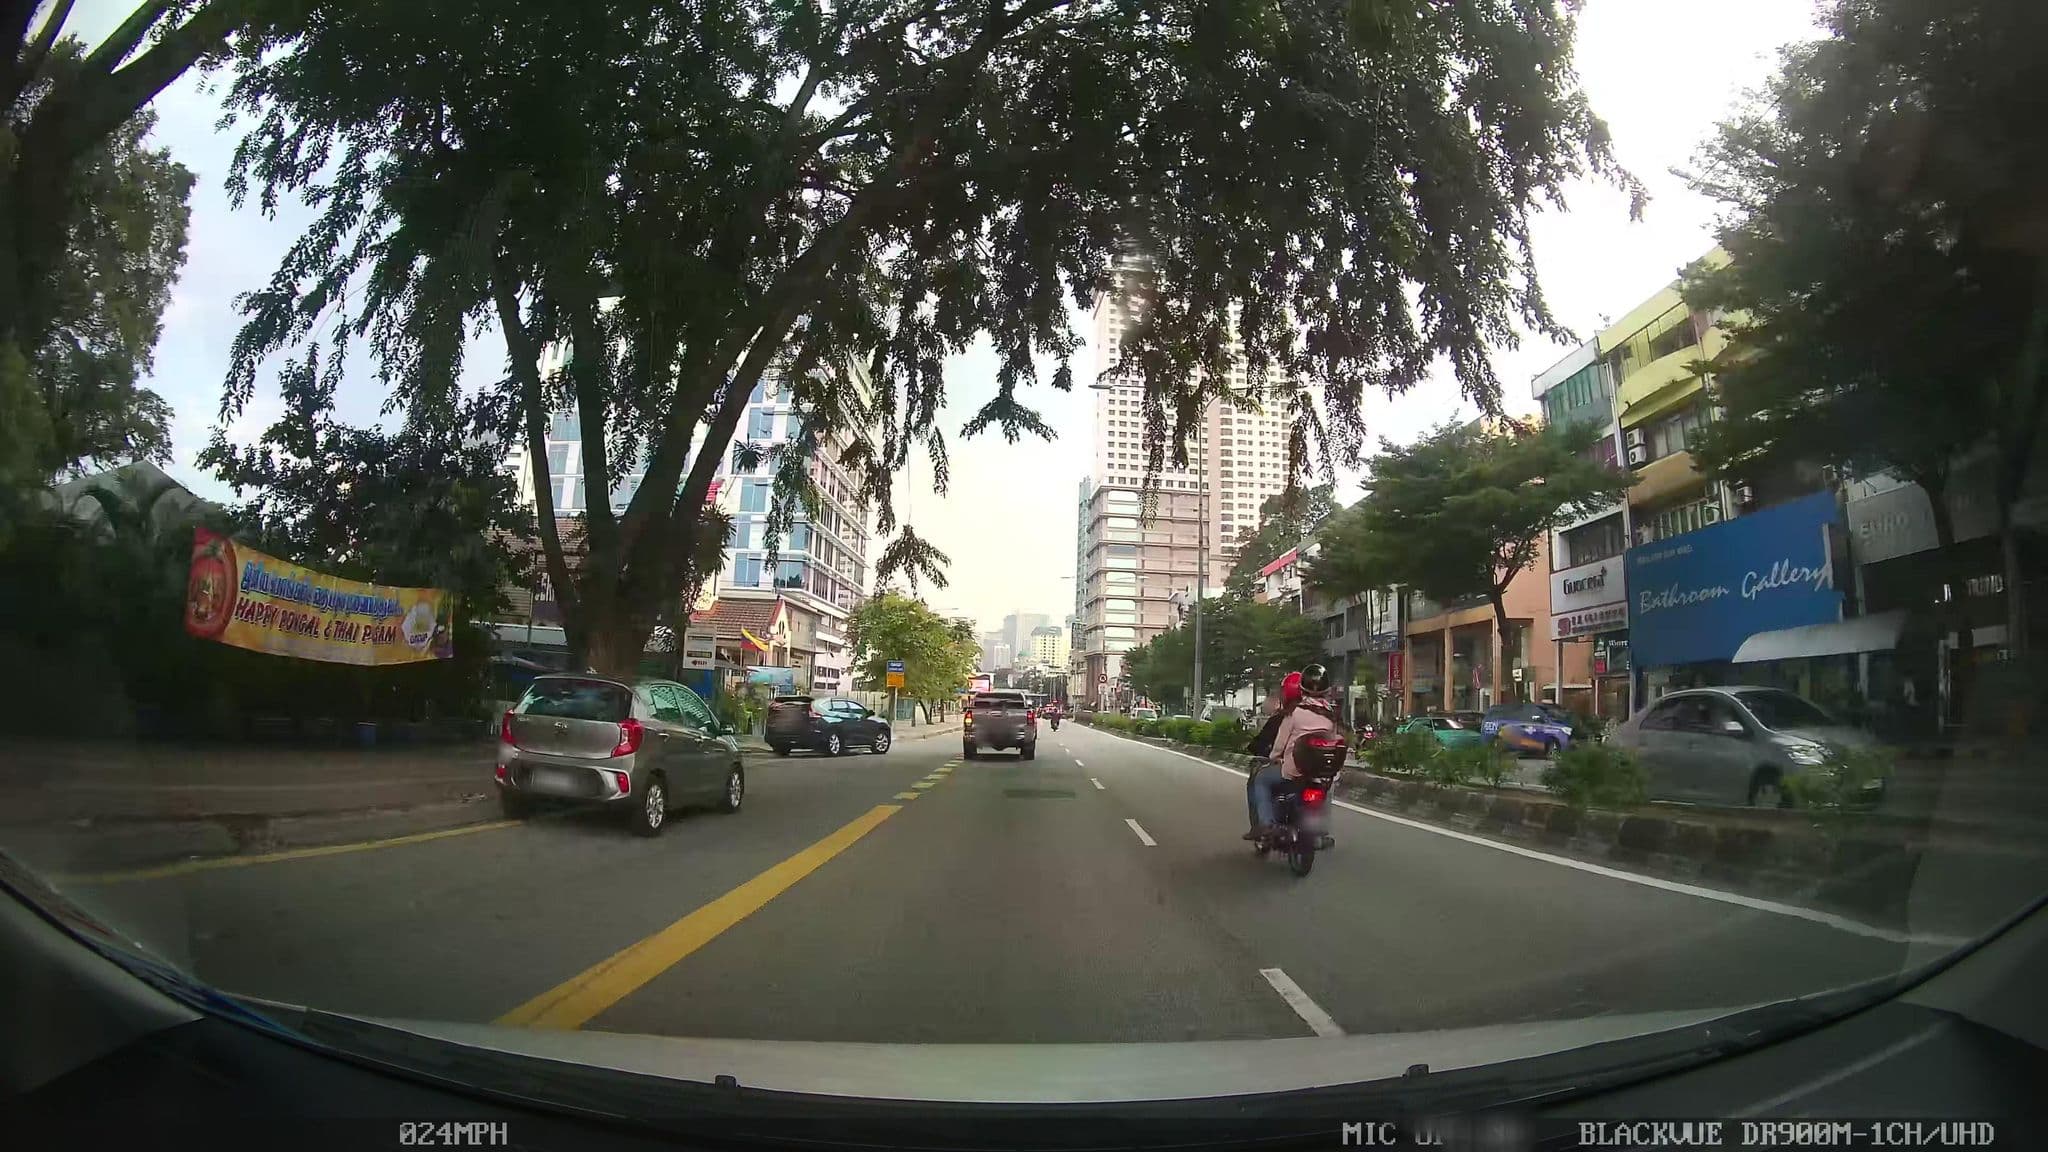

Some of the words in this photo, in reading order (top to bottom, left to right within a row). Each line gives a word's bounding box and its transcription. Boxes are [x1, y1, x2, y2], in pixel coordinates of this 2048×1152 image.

[1639, 581, 1730, 615] Bathroom
[1741, 558, 1831, 601] Gallery
[234, 597, 279, 627] HAPPY
[333, 620, 359, 643] THAI
